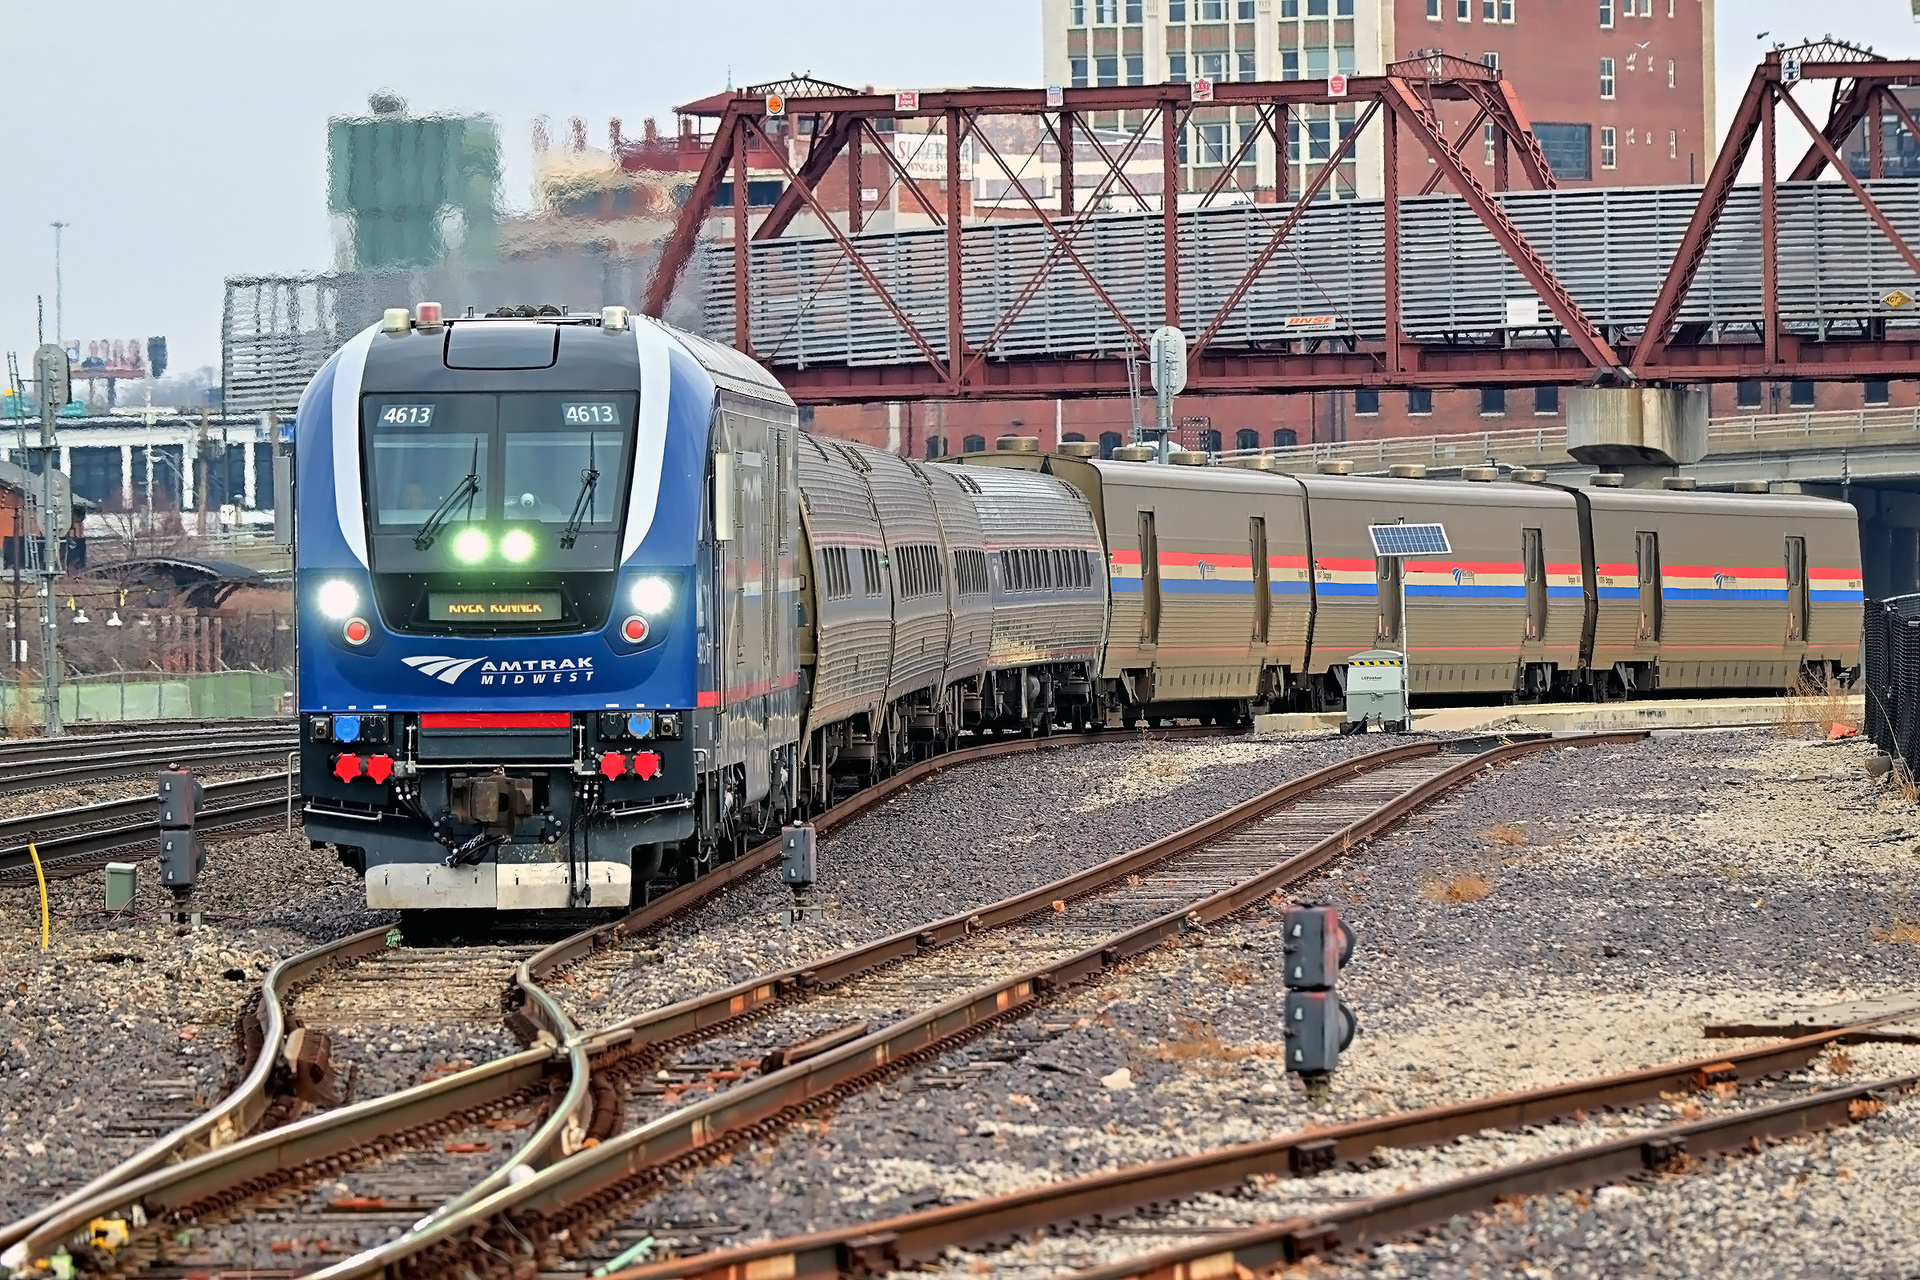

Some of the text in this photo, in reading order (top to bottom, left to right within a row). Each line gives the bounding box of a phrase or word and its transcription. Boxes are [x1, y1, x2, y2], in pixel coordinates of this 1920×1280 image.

[897, 141, 969, 160] SUPERR
[1289, 316, 1333, 324] BNSF
[383, 407, 431, 424] 4613
[566, 406, 614, 422] 4613
[481, 657, 594, 671] AMTRAK
[481, 671, 595, 685] MIDWEST
